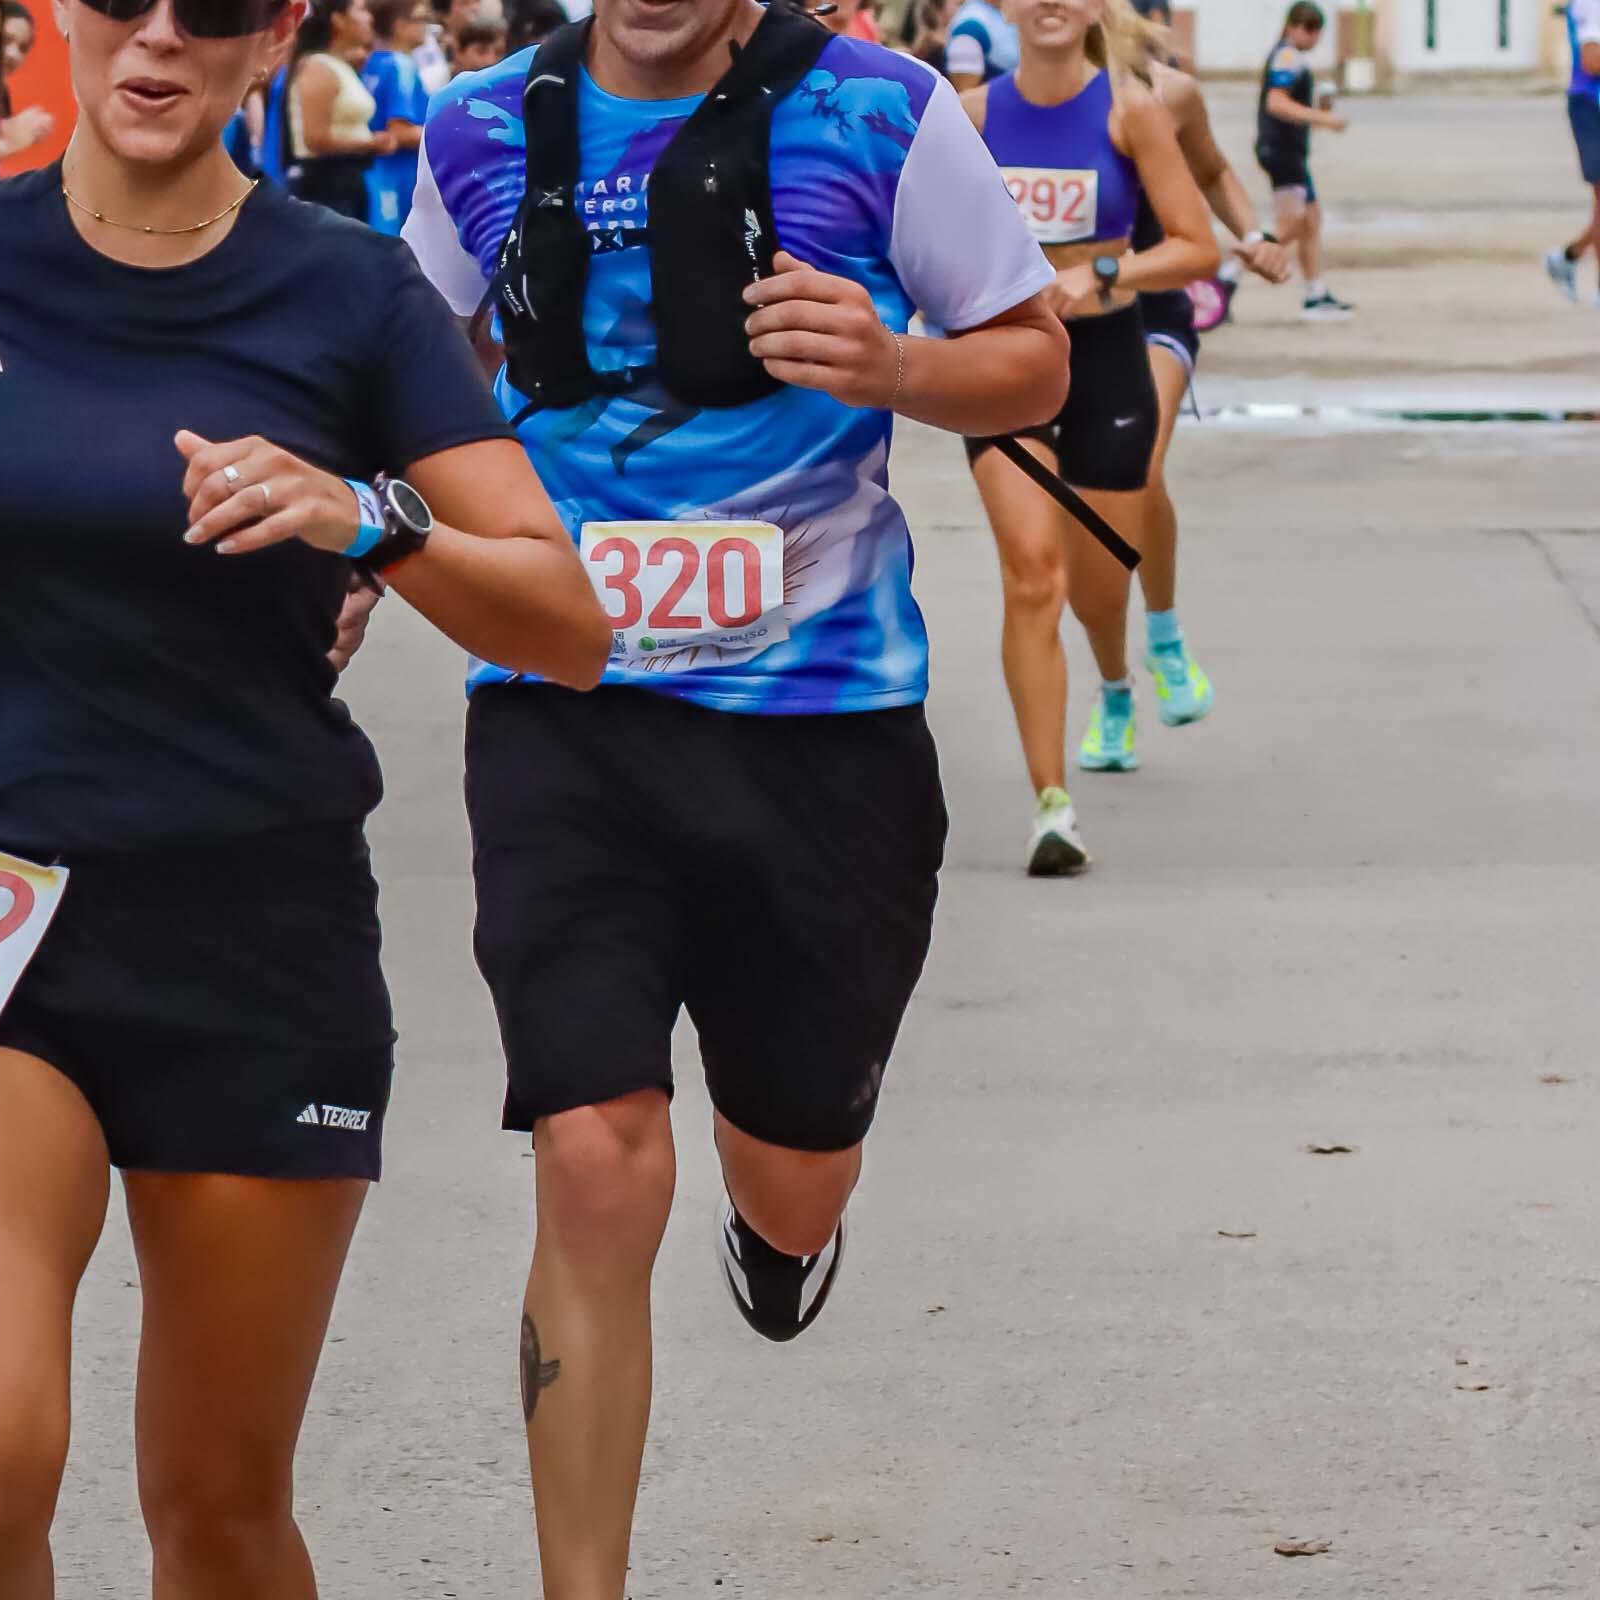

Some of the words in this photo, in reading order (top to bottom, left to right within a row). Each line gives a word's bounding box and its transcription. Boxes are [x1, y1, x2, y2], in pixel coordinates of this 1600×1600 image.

[589, 536, 763, 629] 320
[719, 628, 769, 643] ARUSO
[321, 1104, 371, 1130] TERREX
